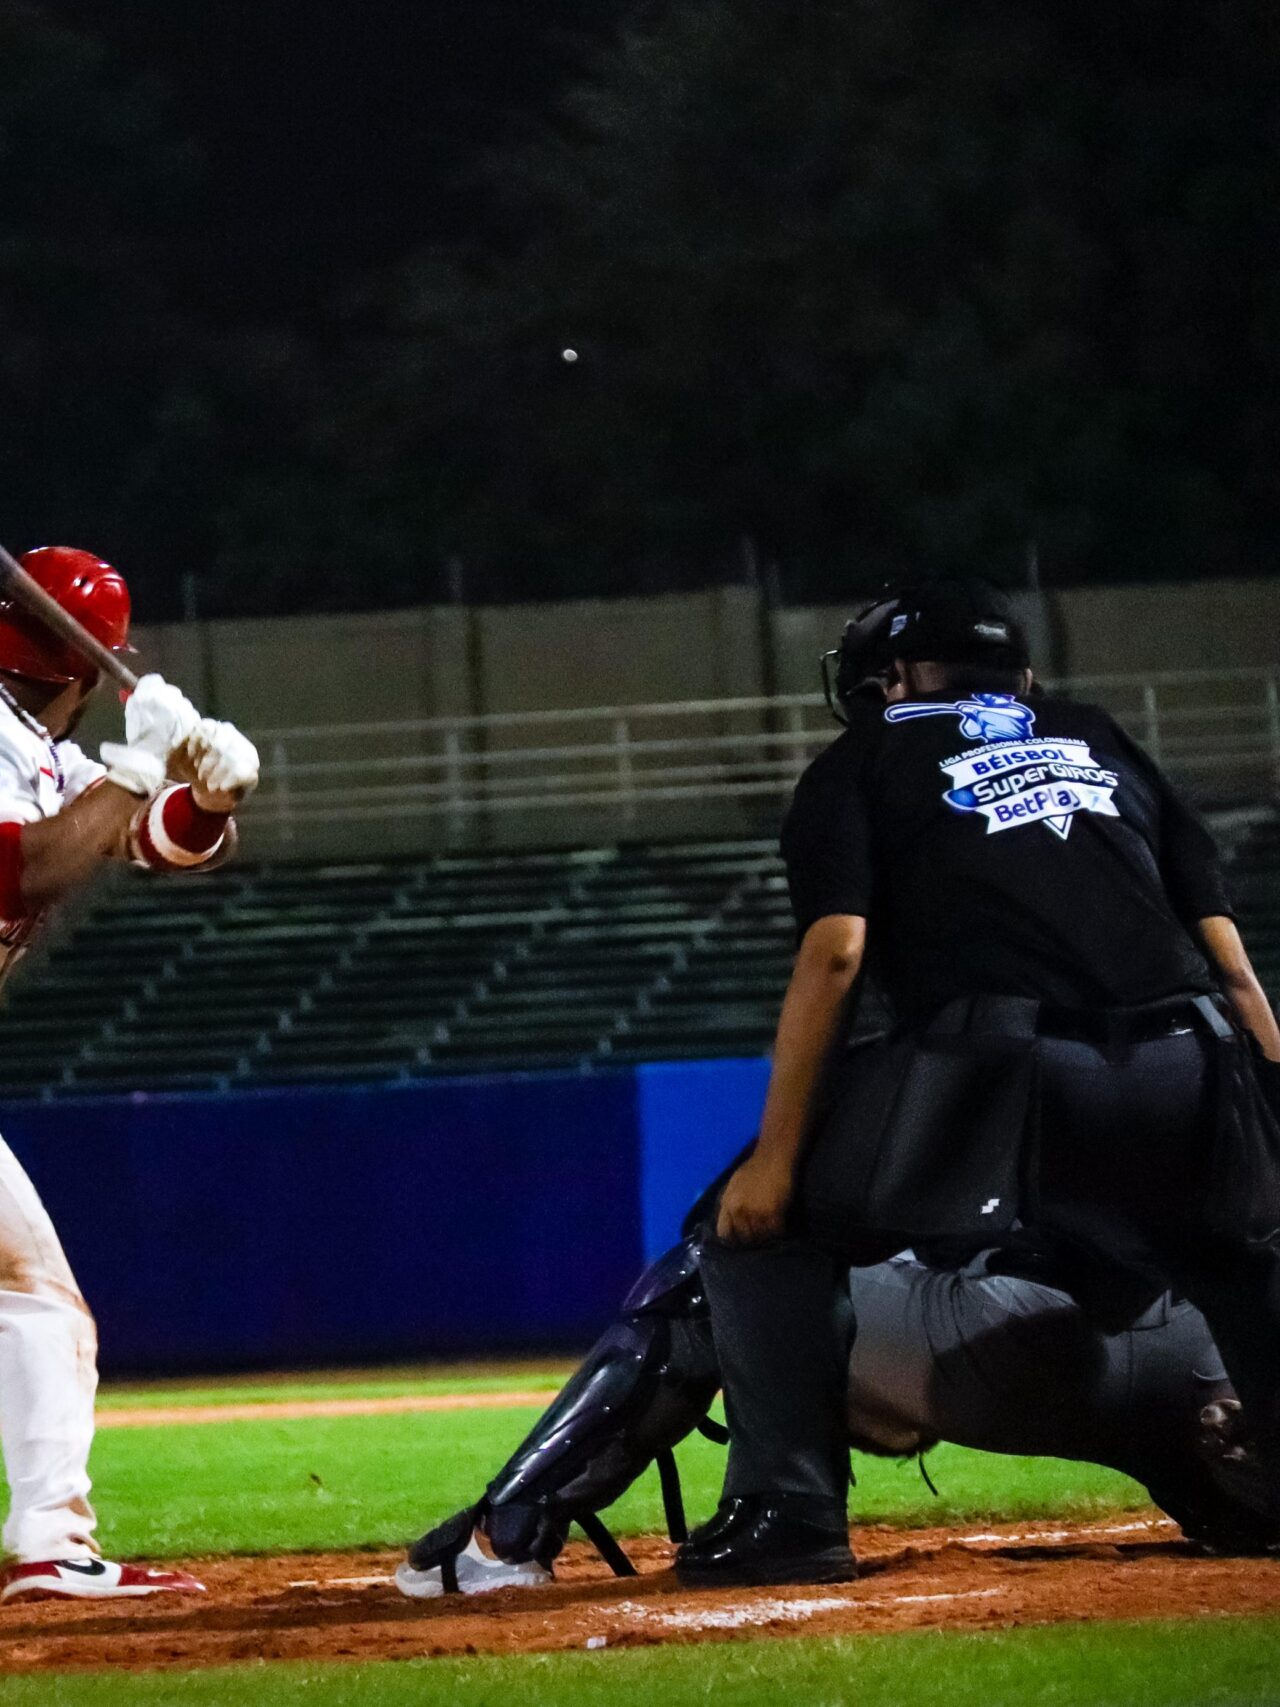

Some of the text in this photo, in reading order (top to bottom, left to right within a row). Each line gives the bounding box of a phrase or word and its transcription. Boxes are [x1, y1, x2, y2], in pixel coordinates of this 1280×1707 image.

[939, 755, 962, 768] LIGA
[961, 740, 1025, 757] PROFESIONAL
[972, 749, 1073, 775] BÉISBOL
